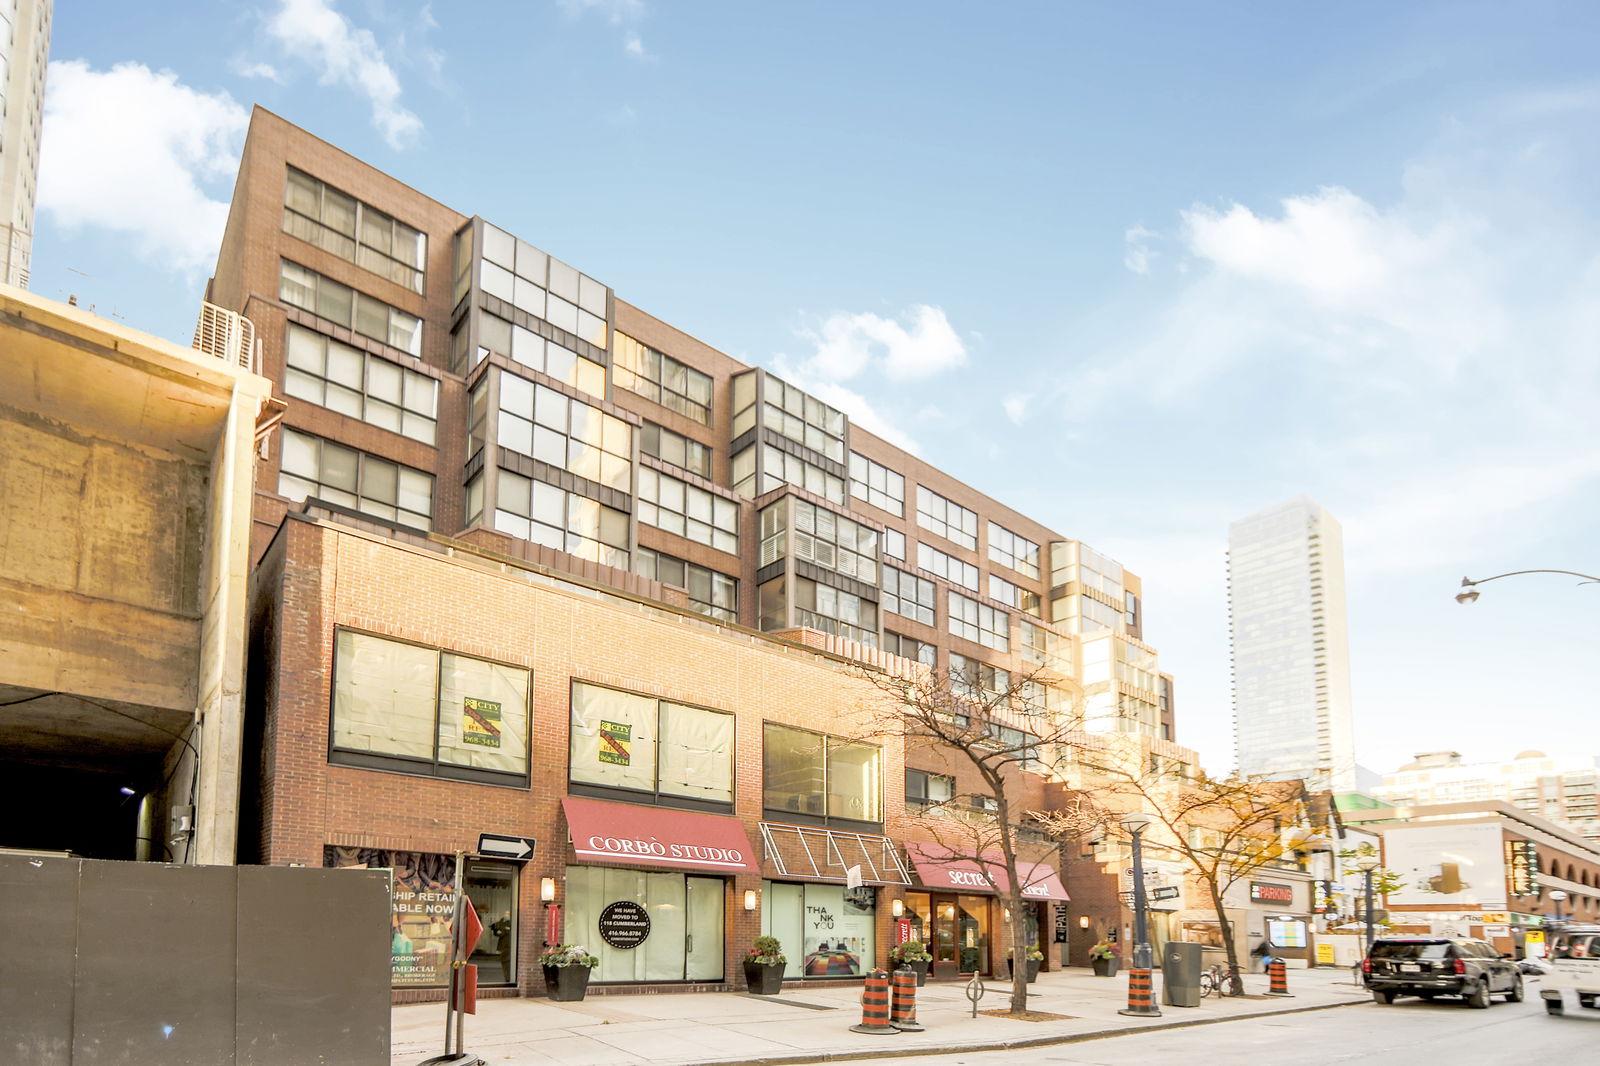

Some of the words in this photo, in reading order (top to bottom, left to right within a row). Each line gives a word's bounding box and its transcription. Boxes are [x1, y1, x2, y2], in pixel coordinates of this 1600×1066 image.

[589, 836, 666, 856] CORBÒ
[670, 844, 743, 862] STUDIO
[1259, 885, 1292, 901] PARKING
